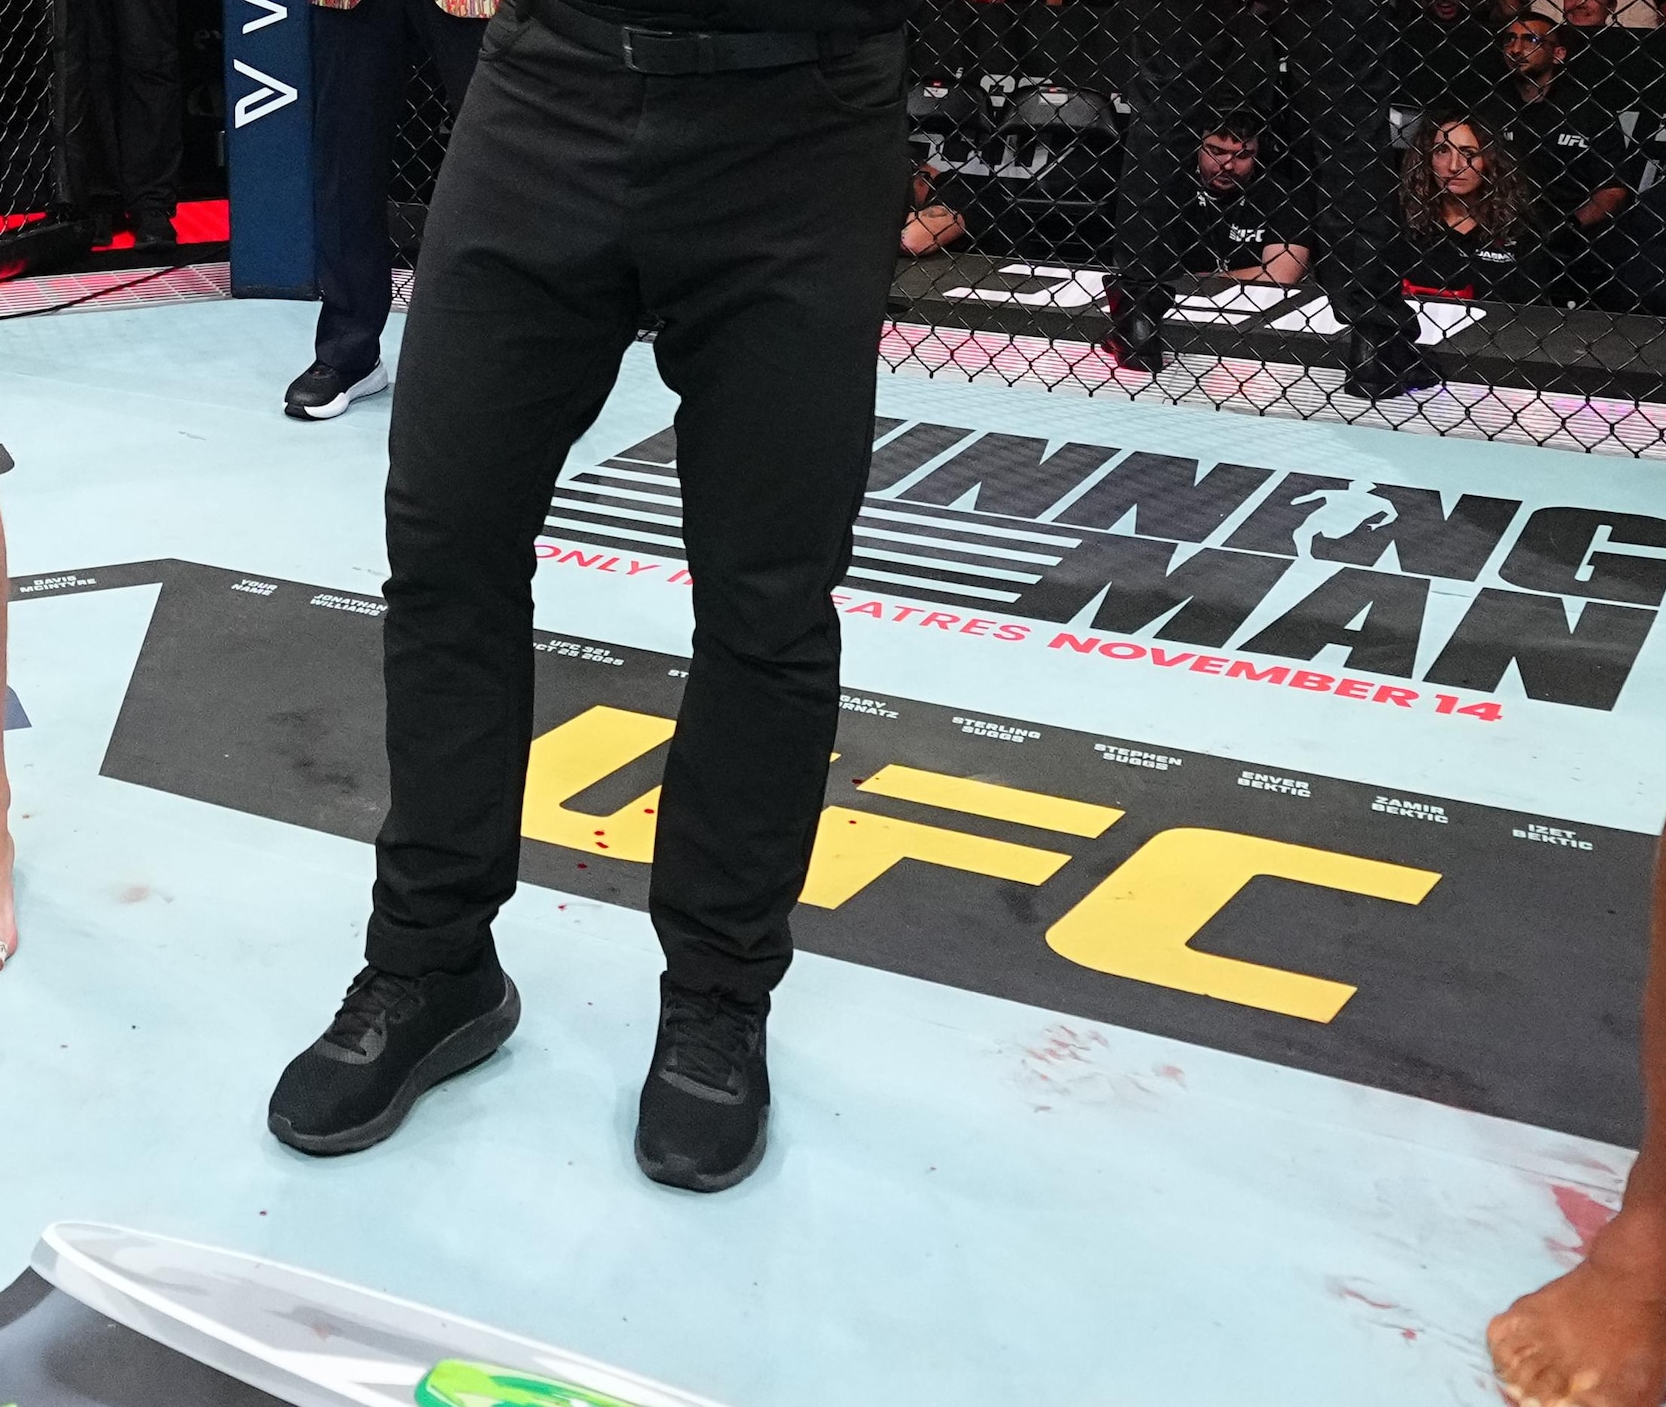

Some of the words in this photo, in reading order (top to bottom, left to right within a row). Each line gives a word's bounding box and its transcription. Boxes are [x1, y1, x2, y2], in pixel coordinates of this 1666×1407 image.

[1557, 133, 1590, 149] UFC
[19, 578, 97, 593] MCINTYRE
[231, 583, 274, 597] NAME
[241, 578, 278, 591] YOUR
[309, 598, 381, 617] WILLIAMS
[313, 594, 388, 612] JONATHAN
[1017, 535, 1659, 712] MAN
[533, 544, 661, 576] ONLY
[1047, 632, 1428, 710] NOVEMBER
[1436, 692, 1505, 725] 14
[549, 639, 581, 652] UFC
[582, 645, 611, 656] 321
[557, 647, 578, 659] 25
[580, 652, 625, 666] 2025
[839, 694, 887, 709] GARY
[952, 716, 1041, 740] STERLING
[961, 725, 1024, 743] SUGGS
[1094, 743, 1182, 766] STEPHEN
[1102, 752, 1168, 771] SUGGS
[1237, 777, 1312, 798] BEKTIC
[1241, 771, 1310, 790] ENVER
[1371, 802, 1449, 824] BEKTIC
[1374, 796, 1445, 815] ZAMIR
[1512, 828, 1594, 851] BEKTIC
[1528, 823, 1576, 839] IZET
[520, 705, 1442, 1025] UFC
